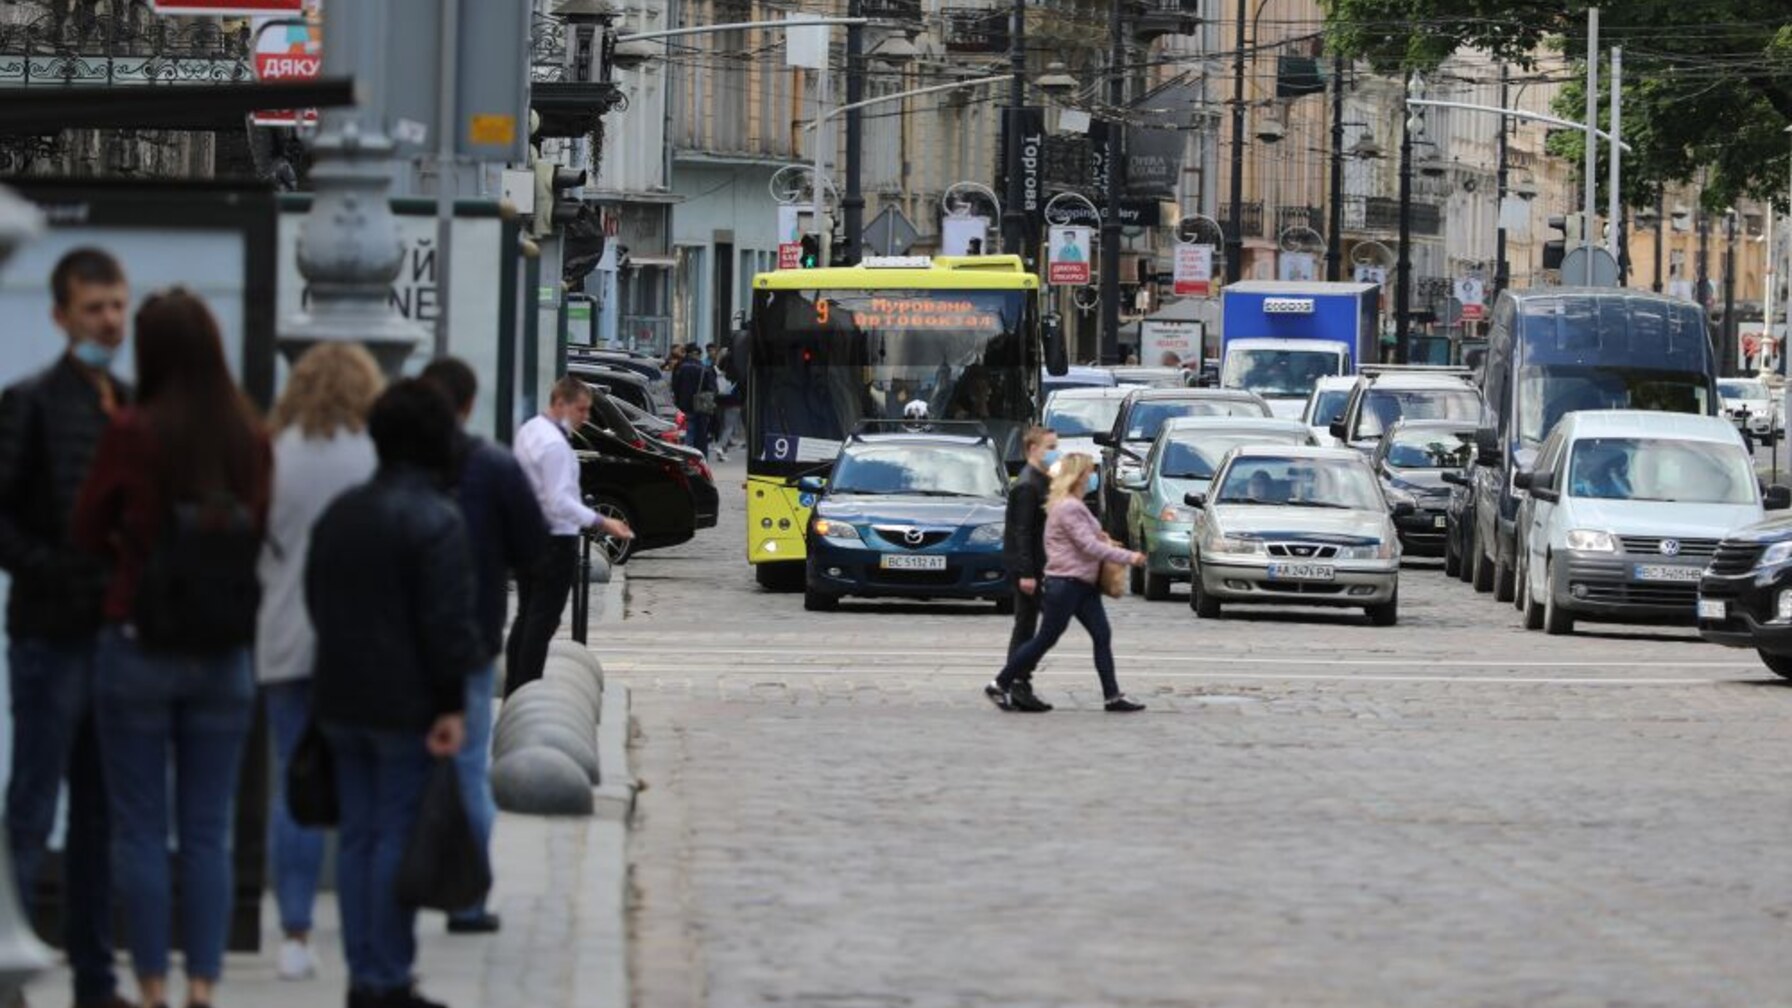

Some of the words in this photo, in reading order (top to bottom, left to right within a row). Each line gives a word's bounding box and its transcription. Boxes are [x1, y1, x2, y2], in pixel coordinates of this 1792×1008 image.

[263, 58, 322, 78] ДЯКУ
[1021, 133, 1041, 211] Торгова
[816, 299, 830, 324] 9
[775, 438, 789, 459] 9
